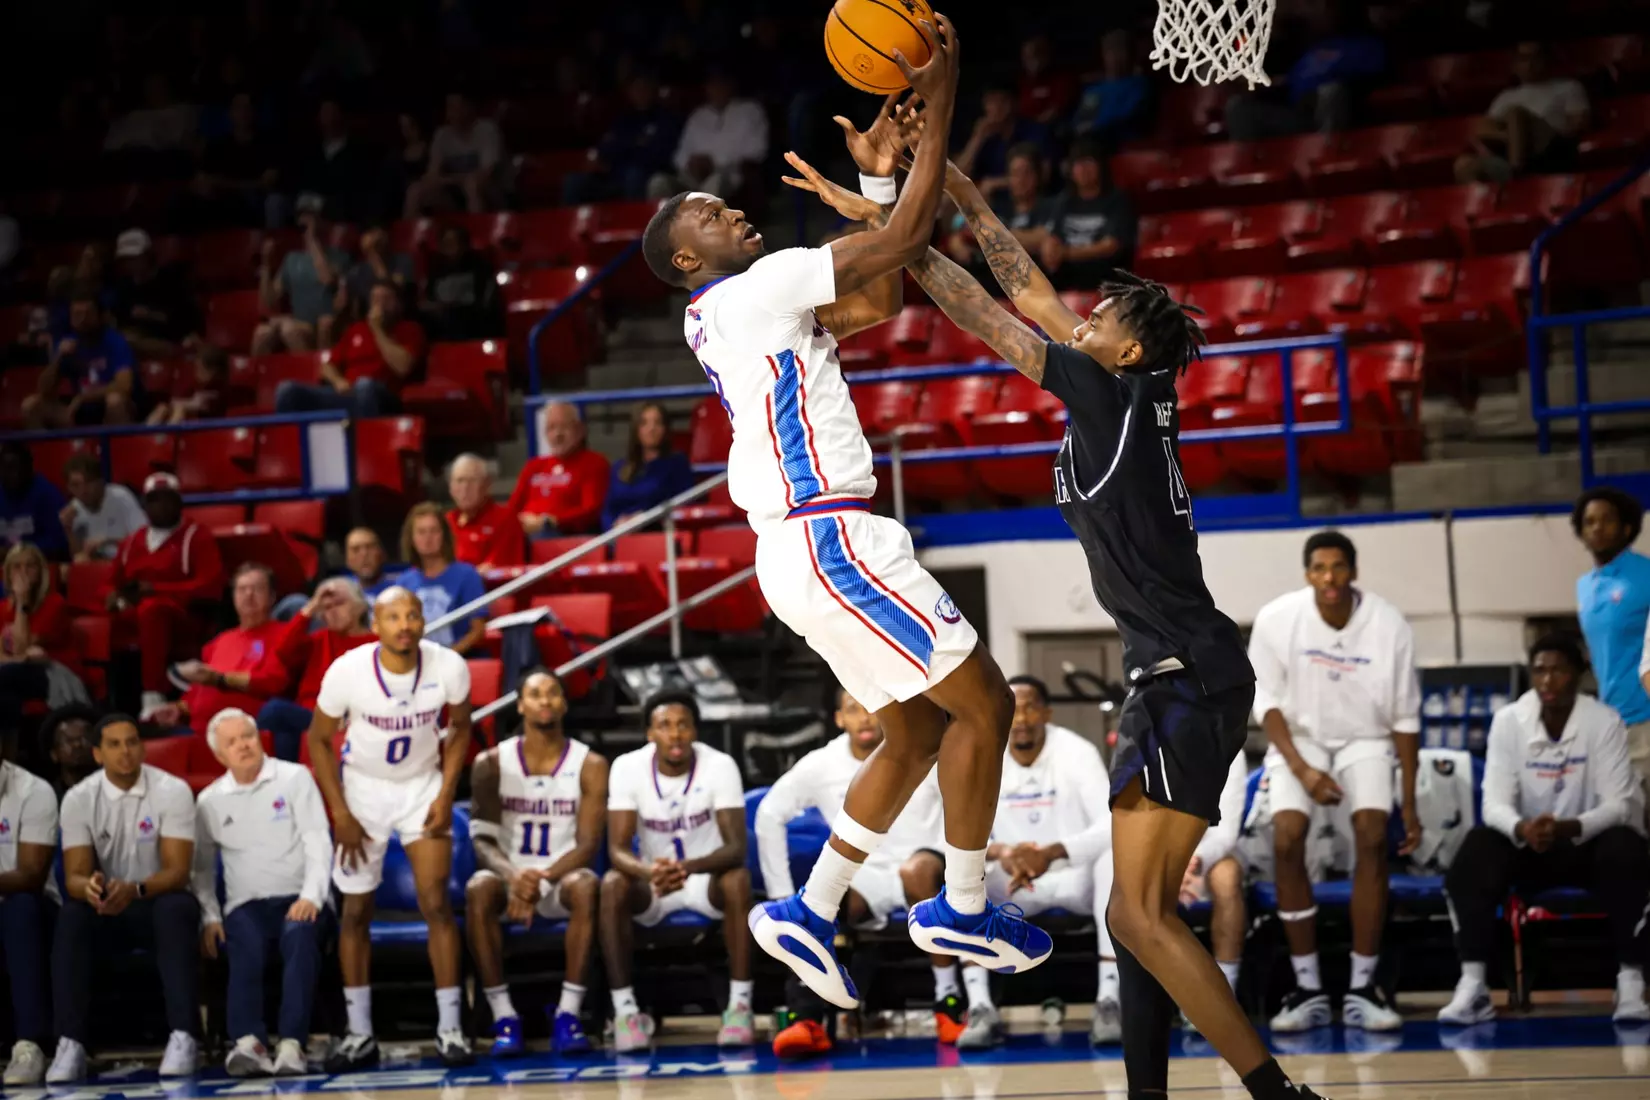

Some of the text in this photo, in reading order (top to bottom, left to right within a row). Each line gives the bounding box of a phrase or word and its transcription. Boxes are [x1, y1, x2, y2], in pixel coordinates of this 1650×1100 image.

[1162, 436, 1194, 530] 4
[386, 735, 411, 765] 0
[520, 821, 550, 856] 11
[672, 837, 685, 861] 1
